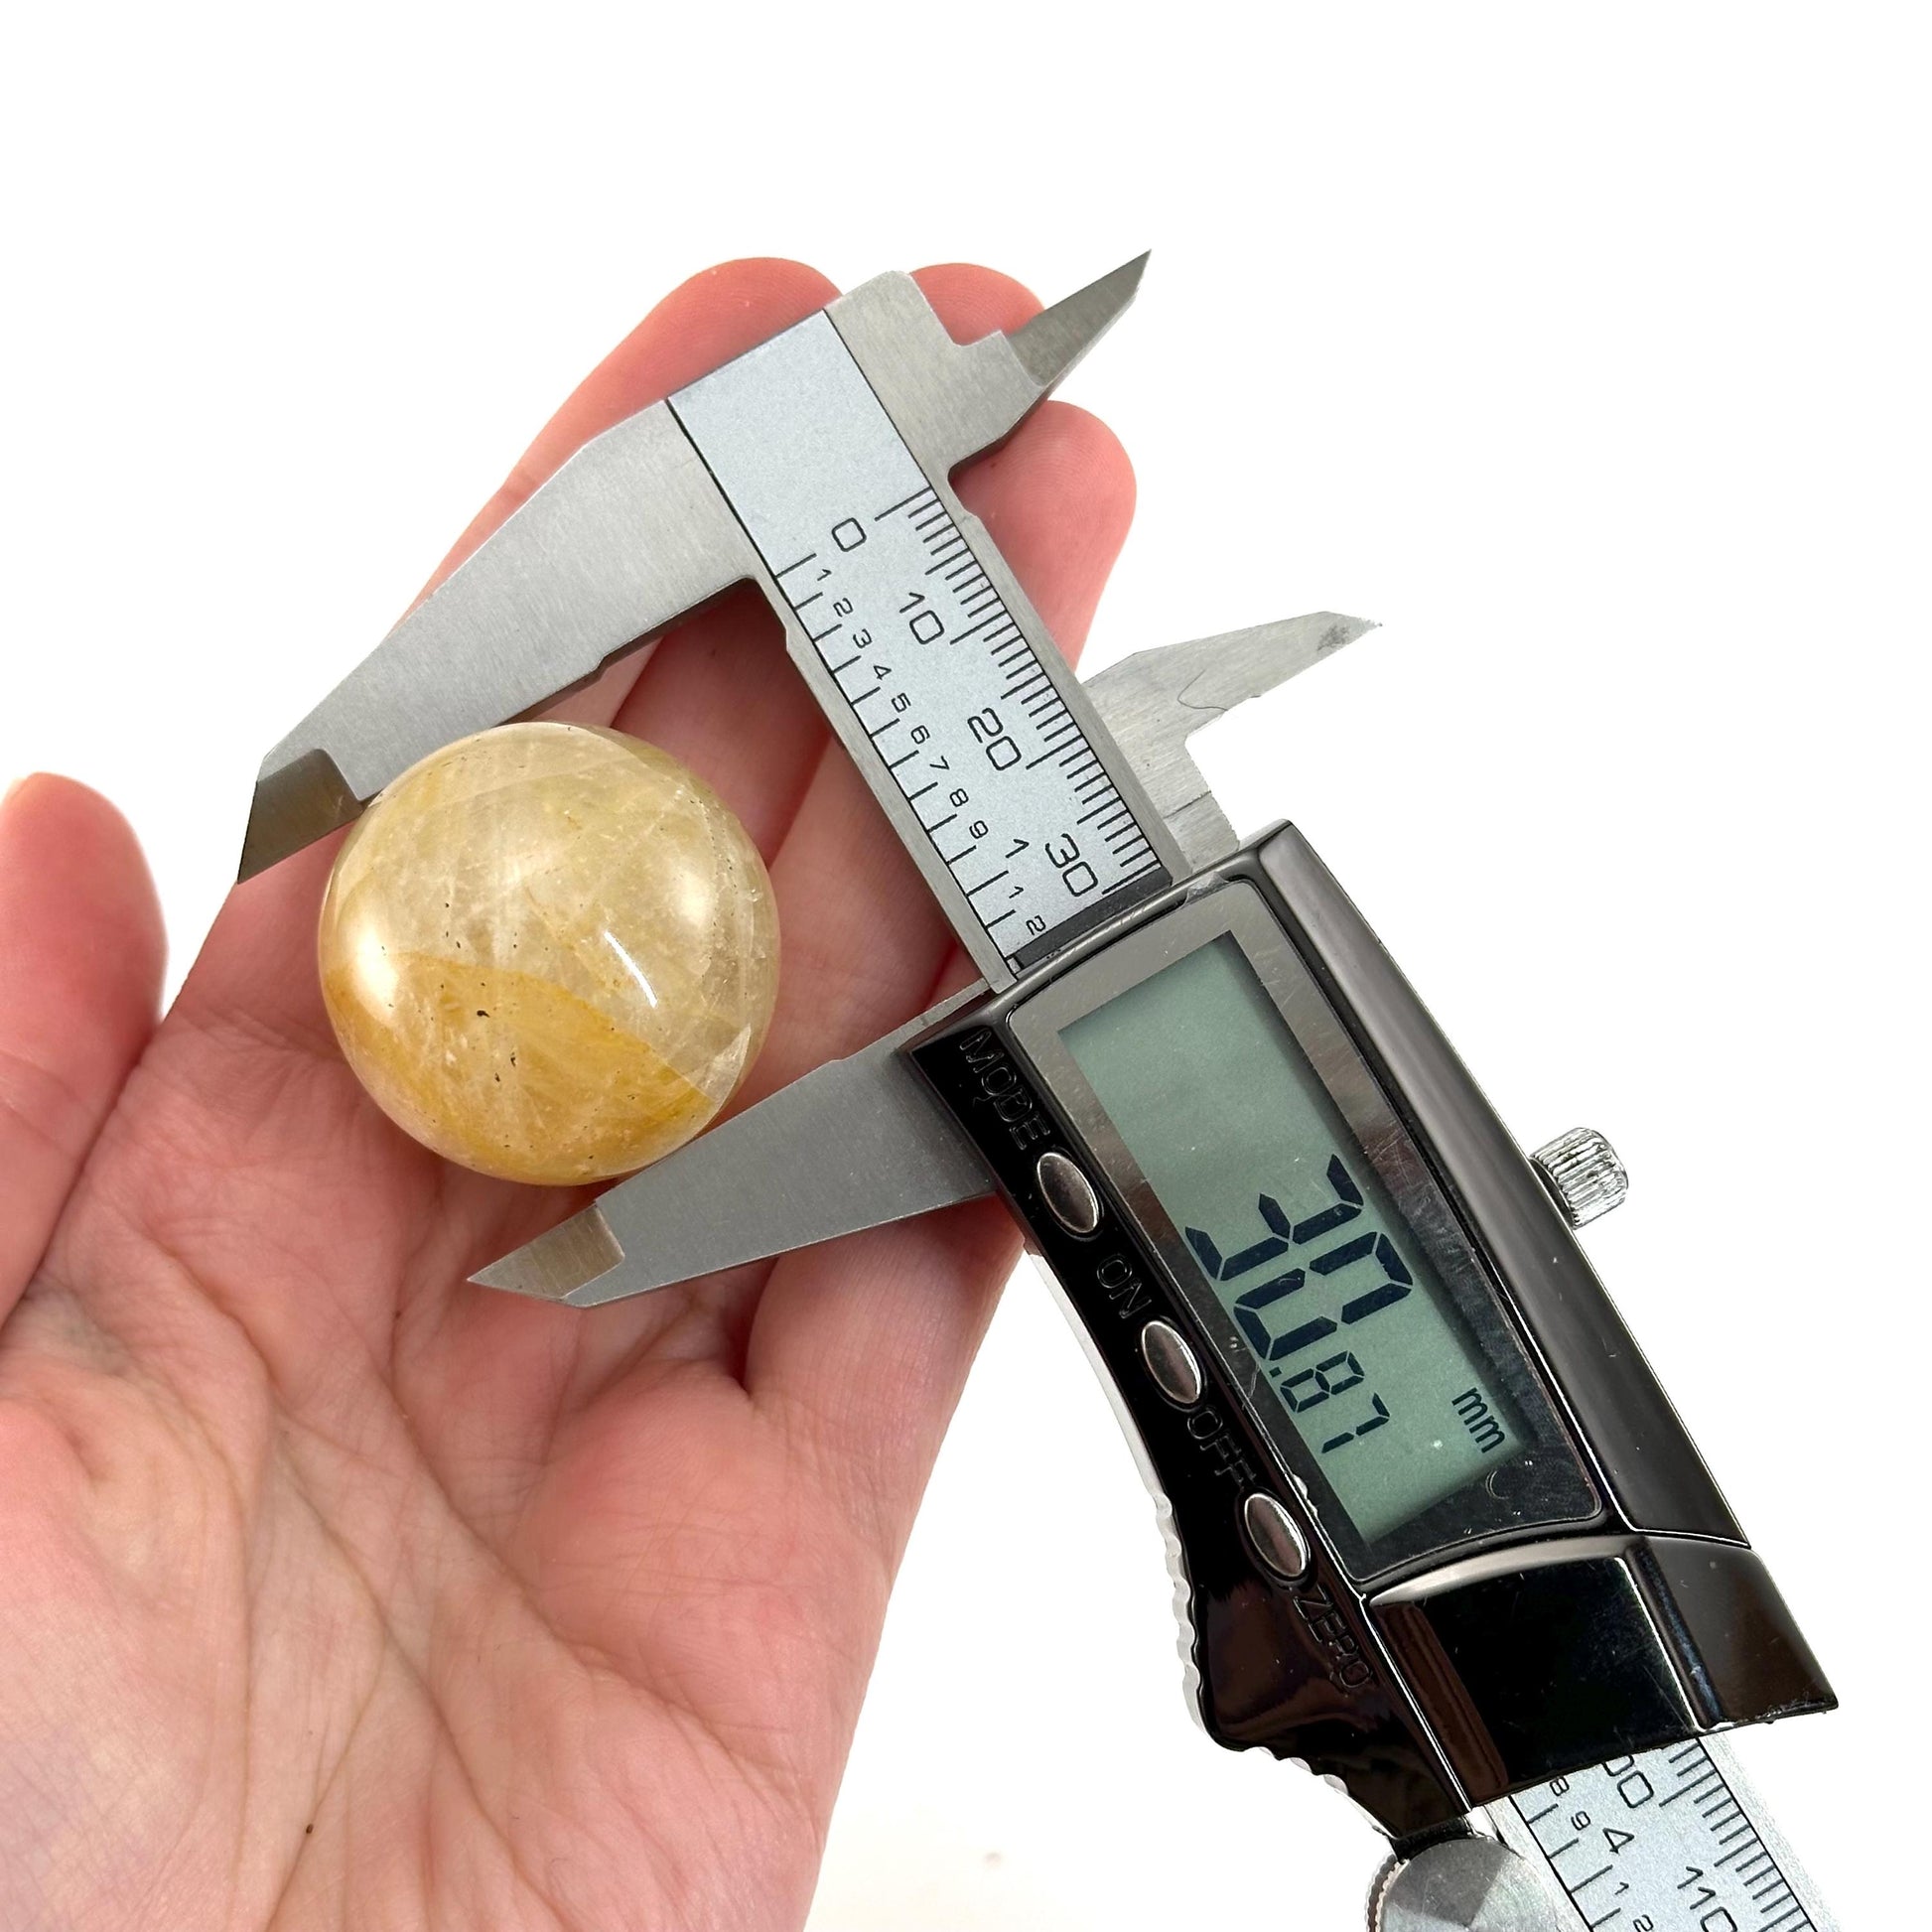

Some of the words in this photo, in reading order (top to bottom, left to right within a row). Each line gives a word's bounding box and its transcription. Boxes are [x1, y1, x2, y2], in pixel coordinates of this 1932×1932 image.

[817, 569, 832, 582] 1
[833, 598, 853, 618] 2
[853, 628, 873, 648] 3
[873, 663, 892, 680] 4
[832, 517, 867, 552] 0
[899, 592, 945, 644] 10
[967, 707, 1022, 770] 20
[1044, 832, 1098, 897] 30
[892, 693, 910, 714] 5
[910, 725, 930, 744] 6
[929, 756, 950, 771] 7
[950, 788, 969, 807] 8
[969, 820, 988, 839] 9
[1006, 838, 1030, 858] 1
[1009, 885, 1024, 899] 1
[1027, 915, 1046, 935] 2
[959, 1028, 1051, 1151] MODE
[1096, 1252, 1153, 1318] ON
[1183, 1154, 1414, 1454] 30.87
[1450, 1387, 1506, 1453] mm
[1185, 1403, 1257, 1488] OFF
[1293, 1584, 1373, 1694] ZERO
[1550, 1777, 1570, 1797] 8
[1571, 1811, 1590, 1831] 9
[1602, 1827, 1634, 1854] 4
[1614, 1881, 1629, 1895] 1
[1677, 1865, 1737, 1932] 110
[1633, 1914, 1653, 1932] 2
